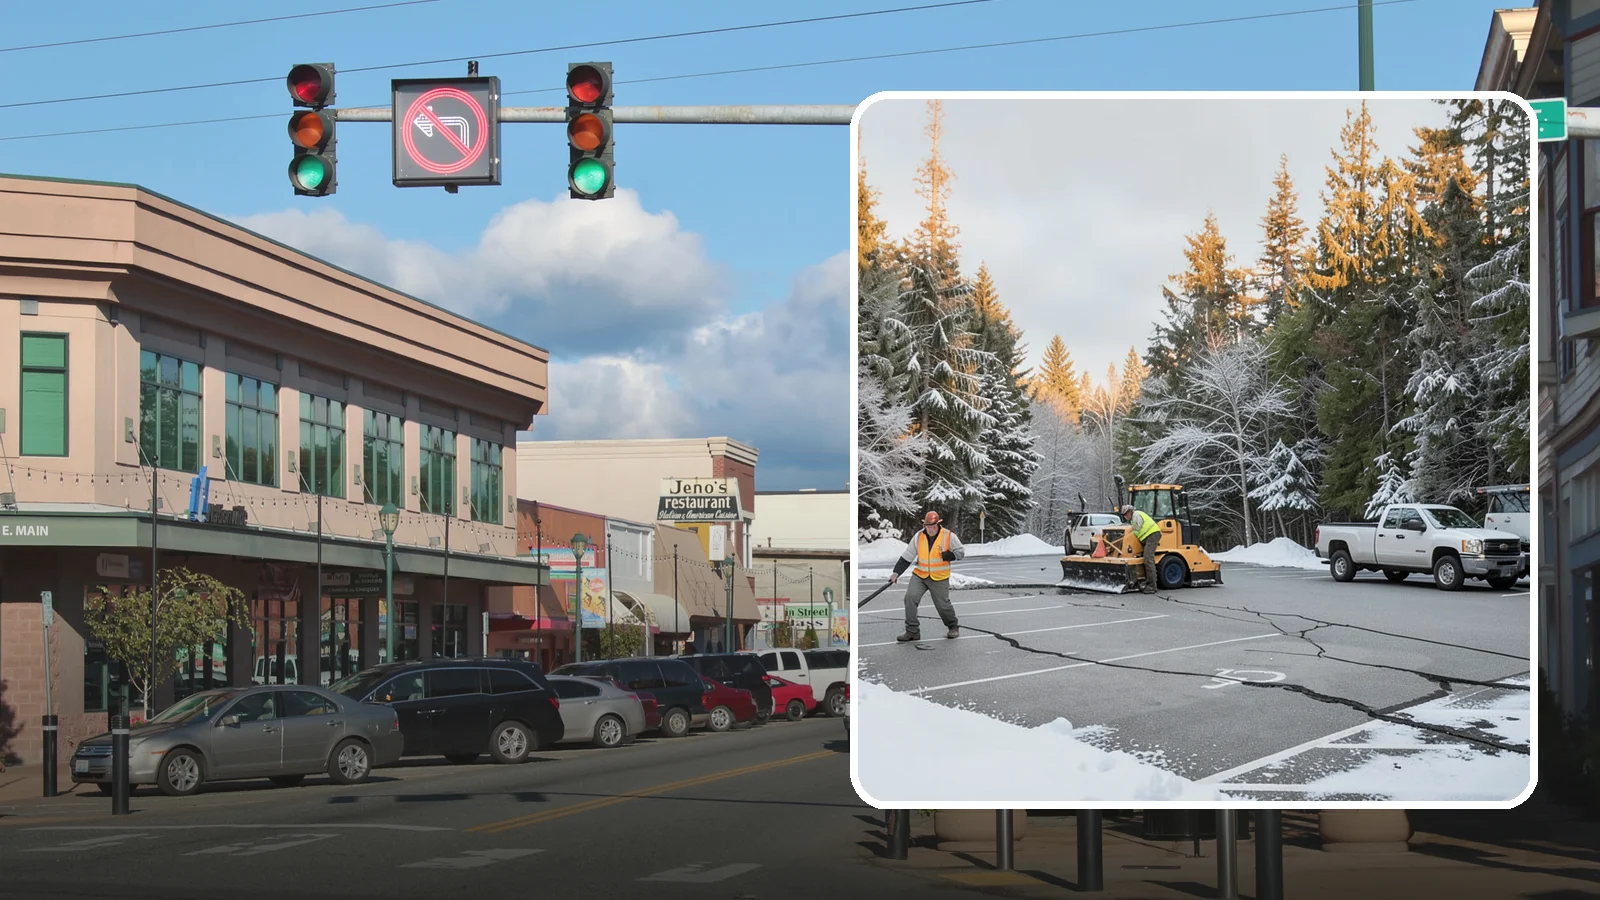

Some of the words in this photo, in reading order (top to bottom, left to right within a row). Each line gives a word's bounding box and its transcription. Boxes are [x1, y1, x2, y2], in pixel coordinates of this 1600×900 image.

[669, 480, 728, 494] Jeno's
[665, 496, 731, 509] restaurant
[658, 510, 681, 519] Italian
[686, 510, 714, 519] American
[715, 510, 738, 519] Cuisine
[2, 525, 13, 536] E.
[15, 525, 49, 536] MAIN
[797, 607, 828, 617] Street
[790, 619, 823, 627] lass
